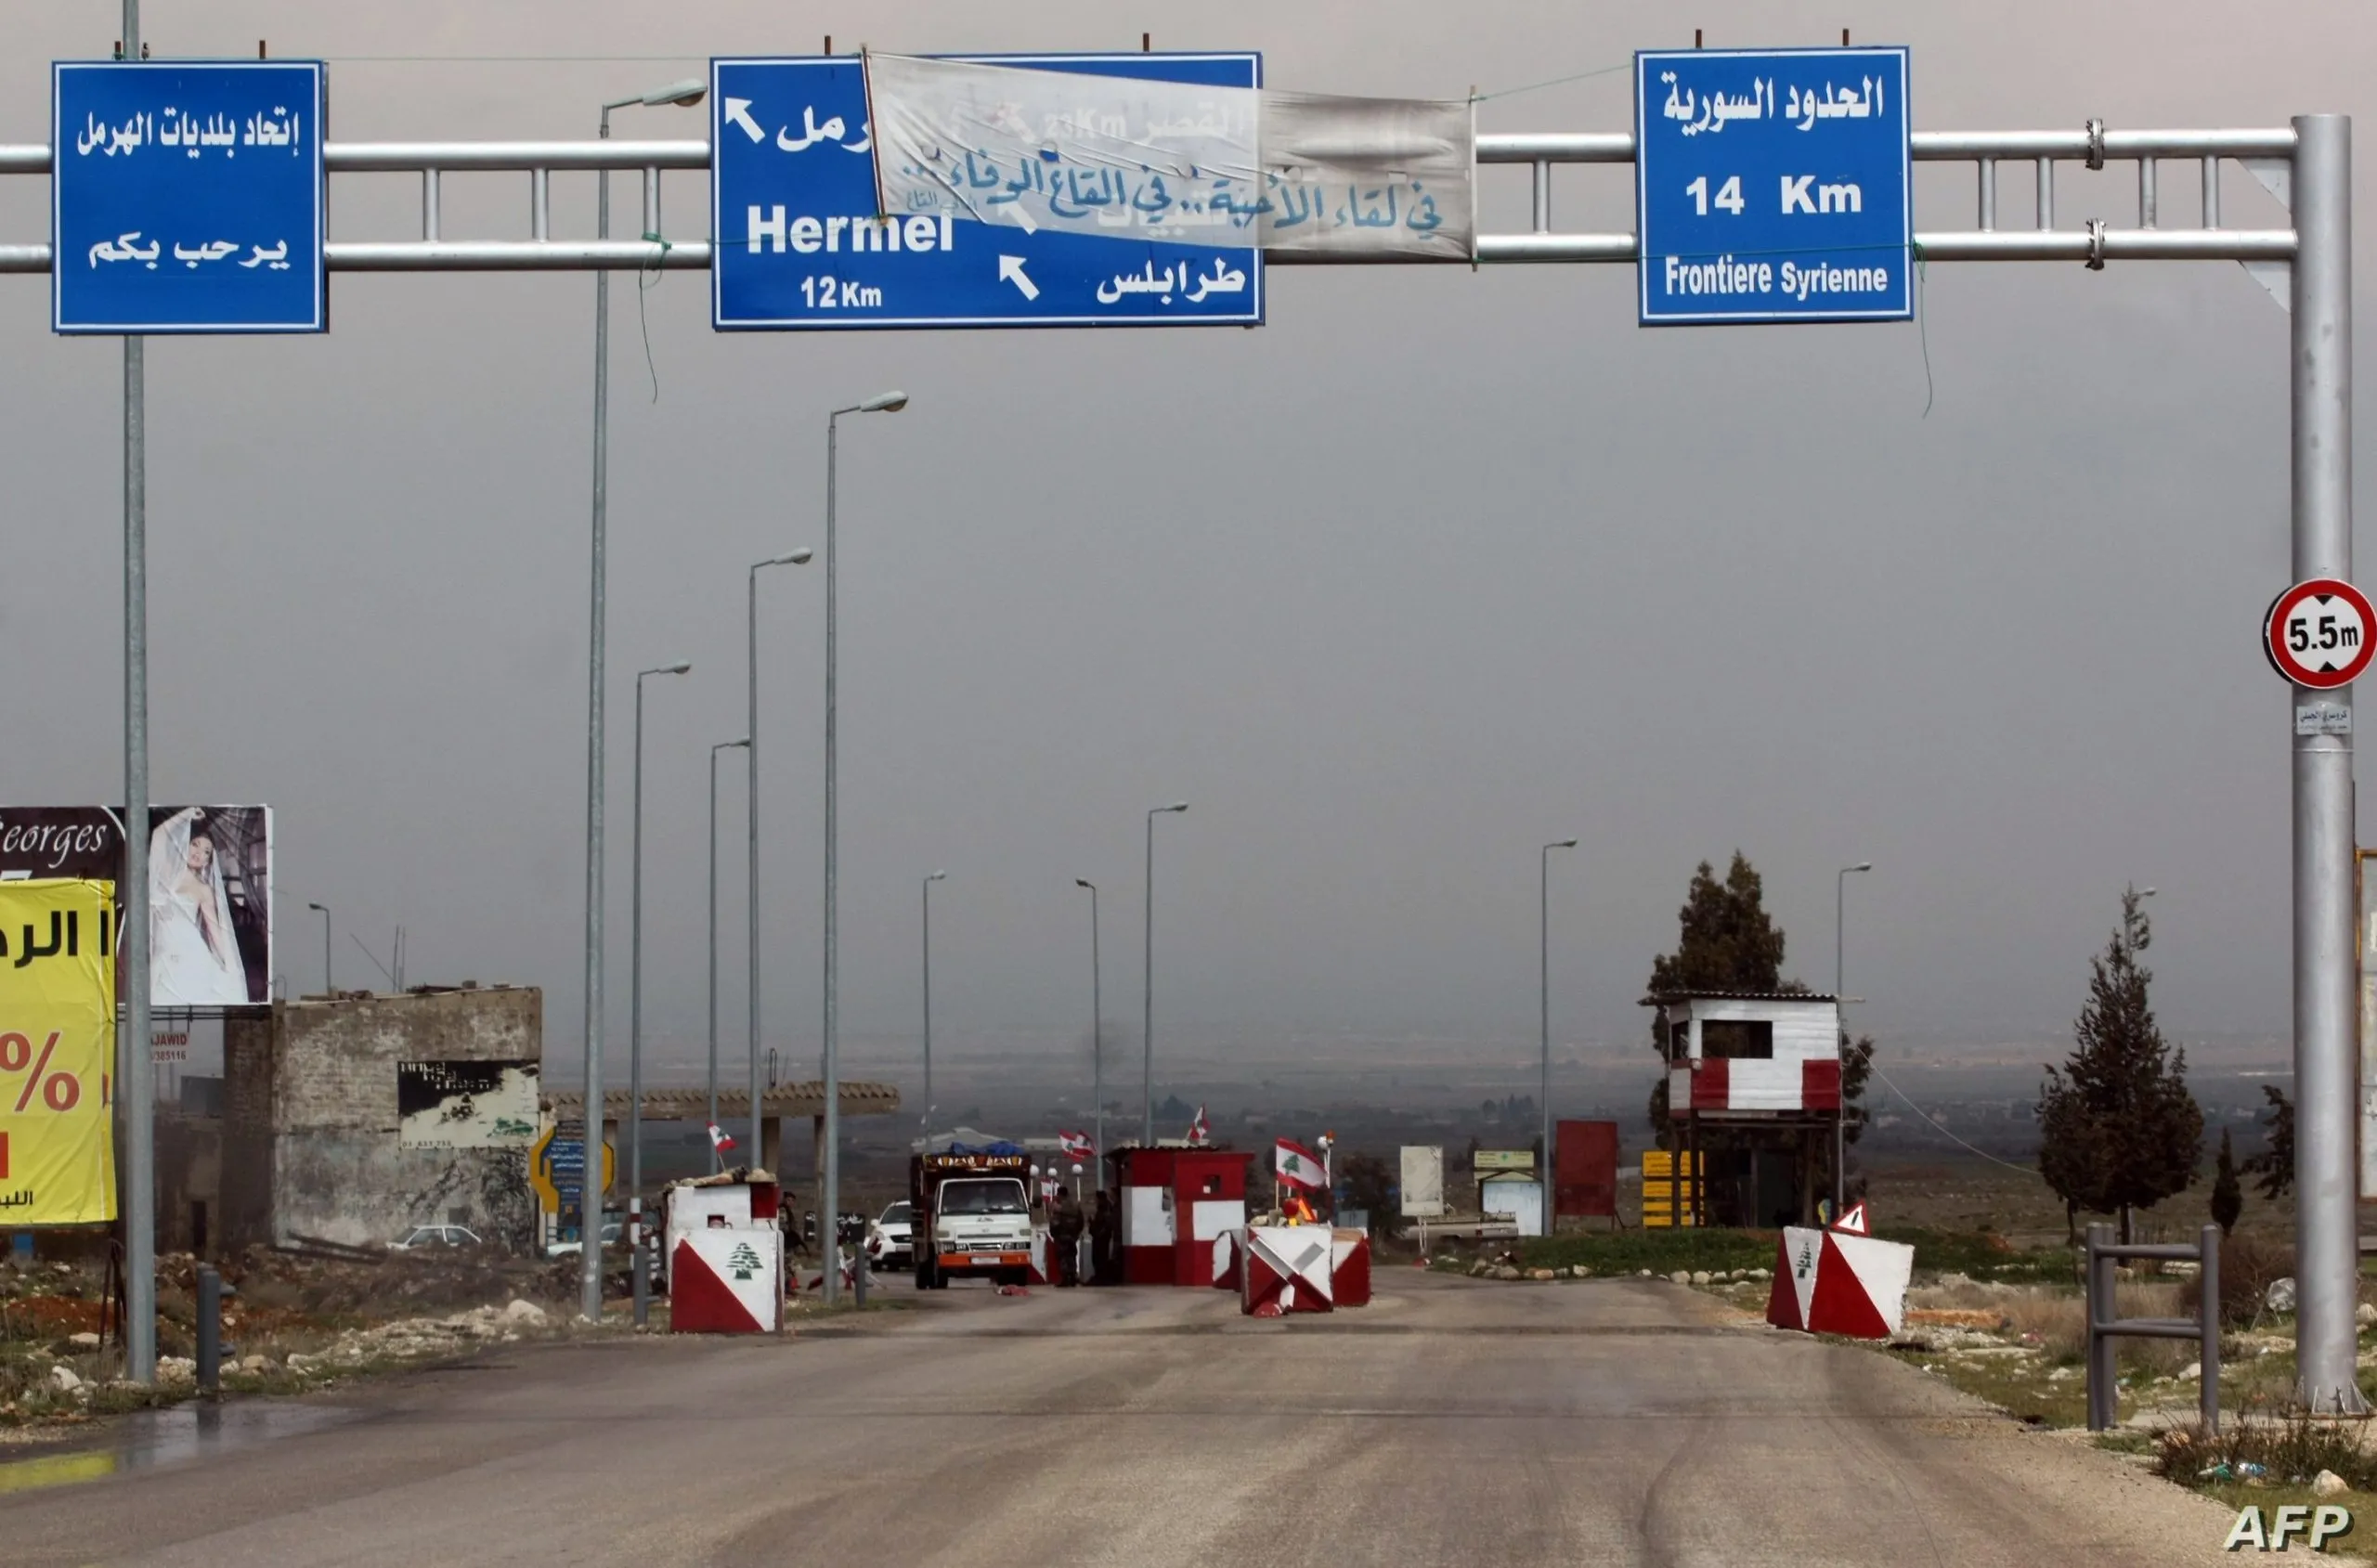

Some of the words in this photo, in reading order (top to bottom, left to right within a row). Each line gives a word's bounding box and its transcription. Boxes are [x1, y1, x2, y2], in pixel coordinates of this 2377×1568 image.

[1660, 71, 1774, 137] السورية
[1785, 73, 1884, 132] الحدود
[77, 110, 153, 157] الهرمل
[160, 106, 237, 160] بلديات
[242, 105, 300, 158] إتحاد
[1048, 166, 1125, 219] القاع
[1405, 179, 1443, 240] في
[1685, 175, 1746, 216] 14
[1780, 175, 1863, 214] Km
[88, 231, 162, 270] بكم
[174, 238, 292, 270] يرحب
[747, 203, 954, 254] Hermel
[1096, 256, 1247, 305] طرابلس
[1665, 253, 1773, 295] Frontiere
[1780, 261, 1889, 302] Syrienne
[2289, 615, 2359, 653] 5.5m
[0, 815, 107, 869] eorges
[0, 910, 78, 968] الر
[150, 1032, 188, 1046] JAWID
